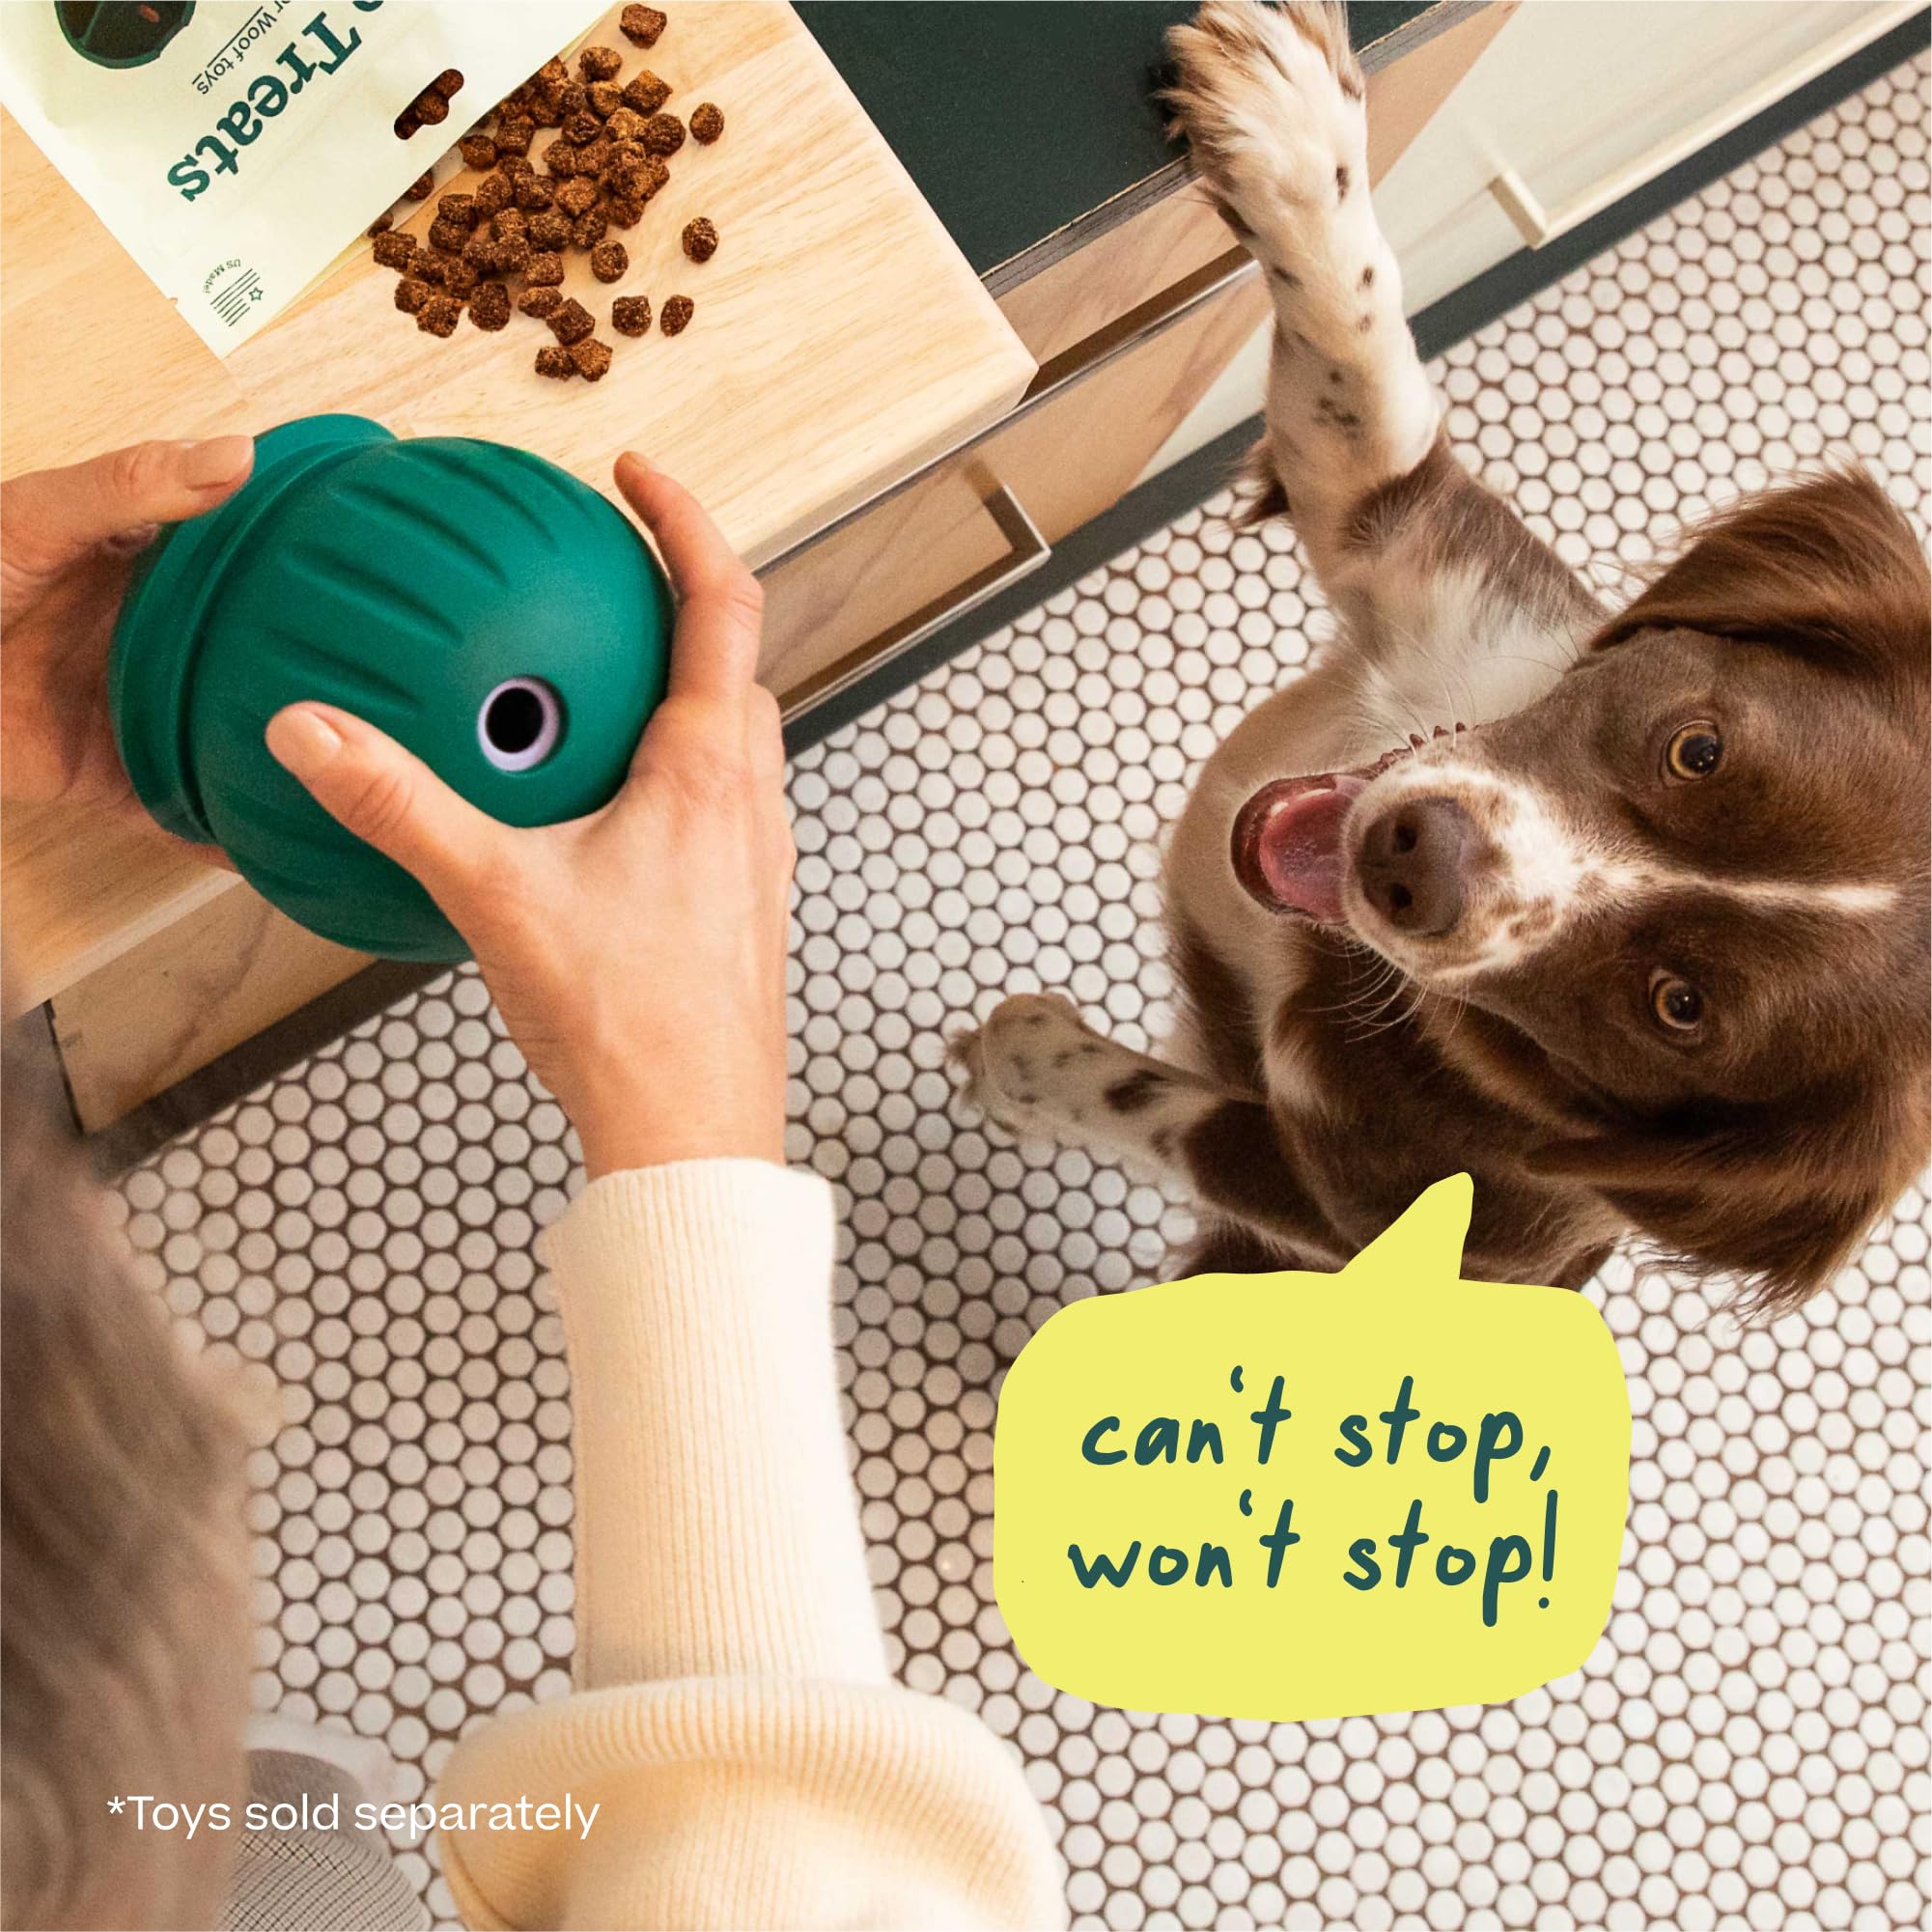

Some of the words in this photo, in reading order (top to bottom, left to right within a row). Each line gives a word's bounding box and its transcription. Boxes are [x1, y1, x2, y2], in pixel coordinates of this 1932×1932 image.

[232, 12, 277, 62] Woof
[196, 57, 234, 95] toys
[167, 11, 362, 202] Treats
[225, 259, 241, 269] US
